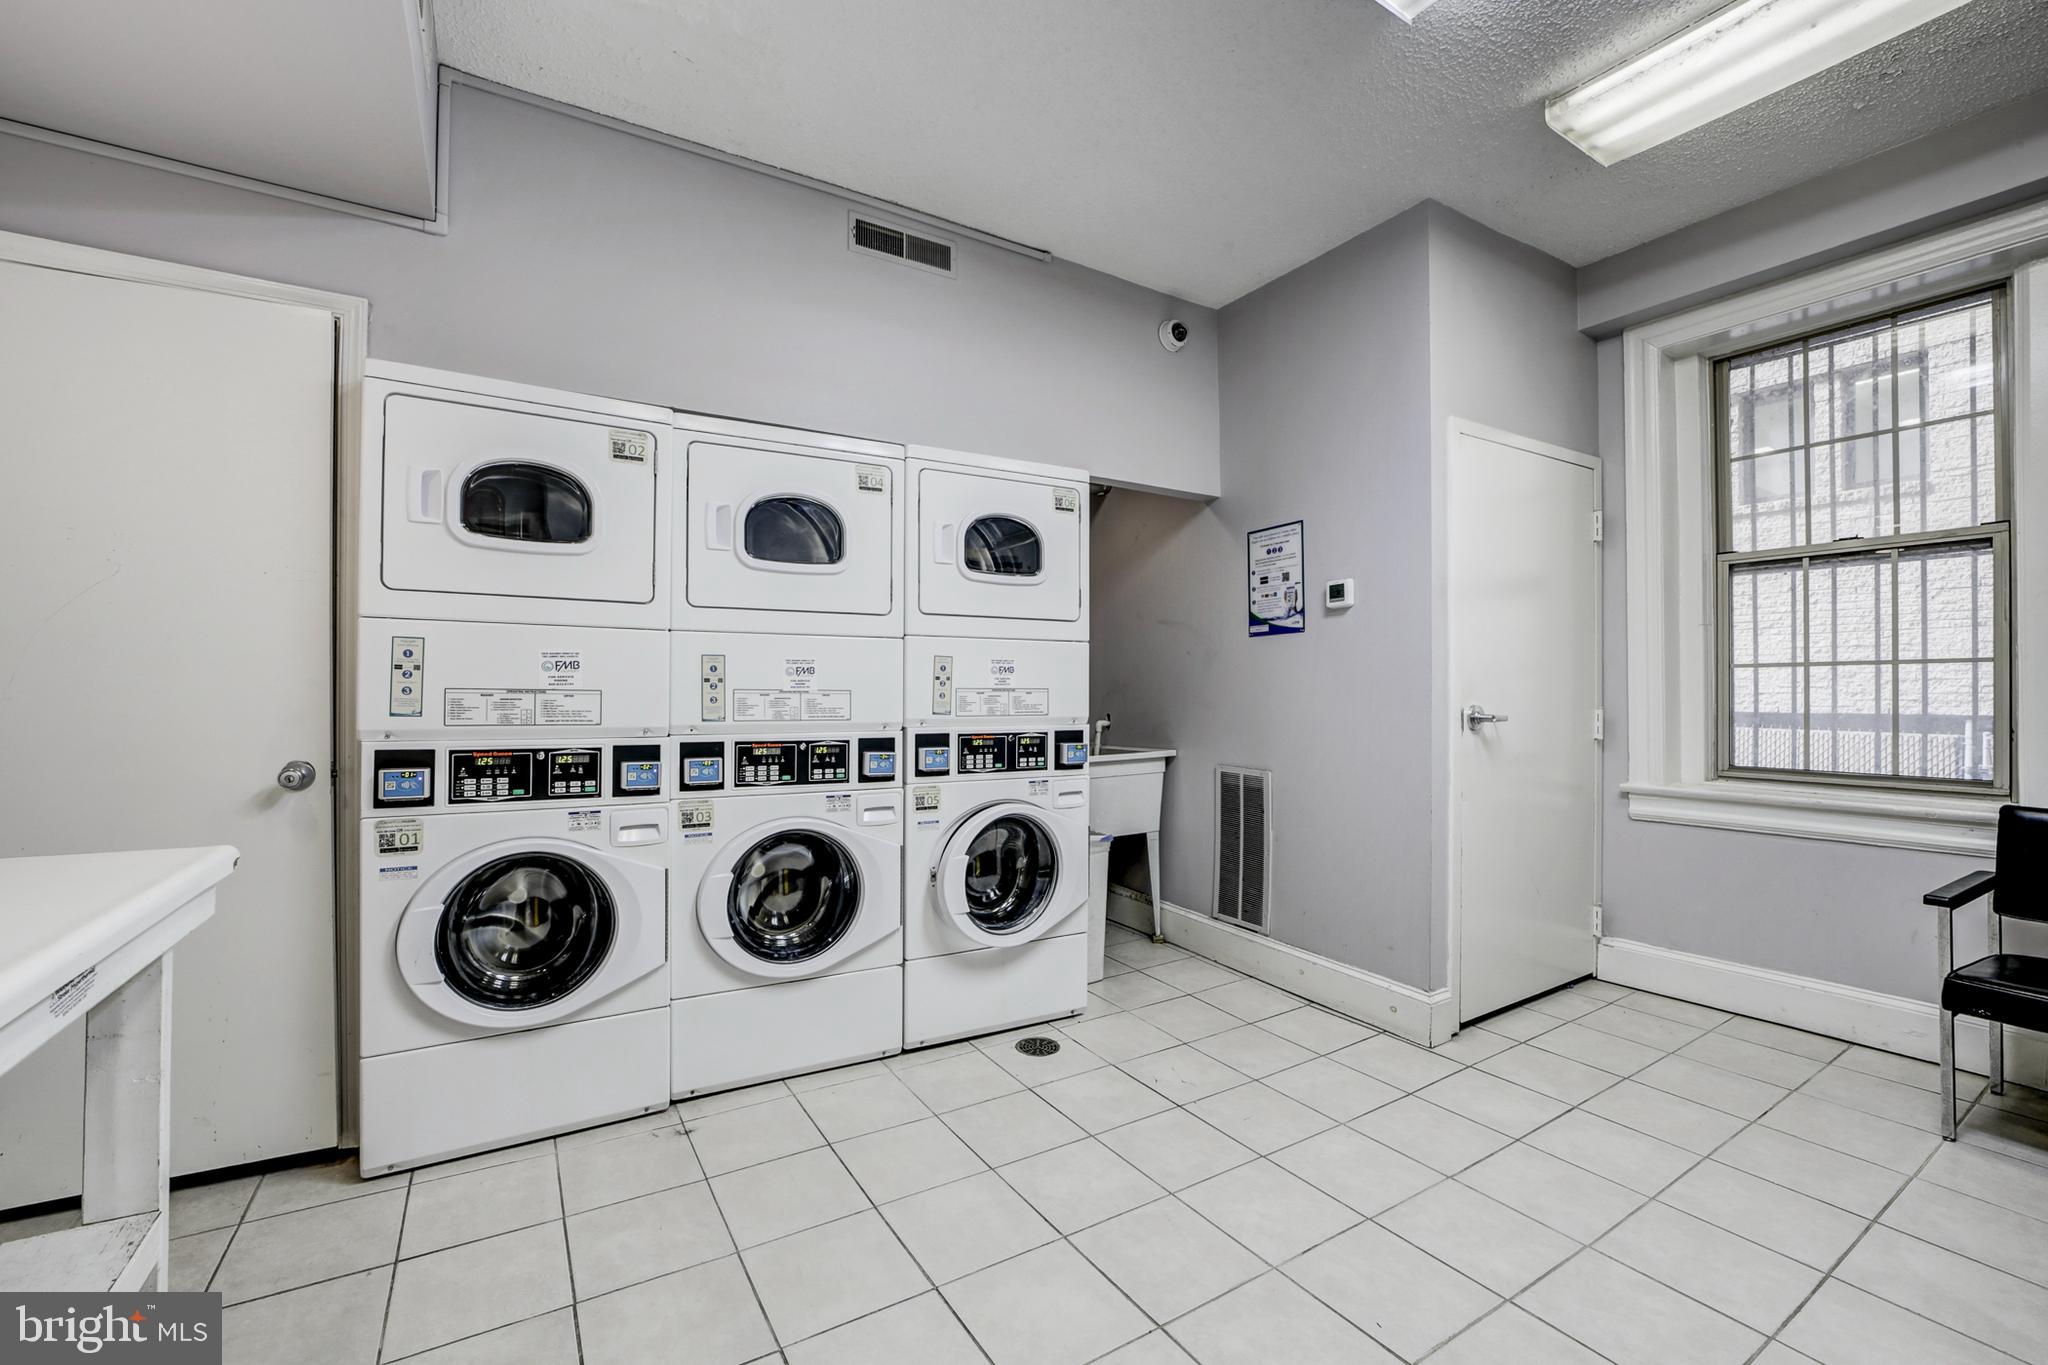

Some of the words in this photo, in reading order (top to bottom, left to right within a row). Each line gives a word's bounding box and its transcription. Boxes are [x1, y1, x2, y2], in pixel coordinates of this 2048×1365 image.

[629, 444, 645, 456] 02
[870, 477, 883, 487] 04
[555, 660, 580, 672] FMB
[795, 666, 815, 677] FMB
[927, 795, 939, 805] 05
[696, 811, 711, 822] 03
[399, 832, 419, 845] 01
